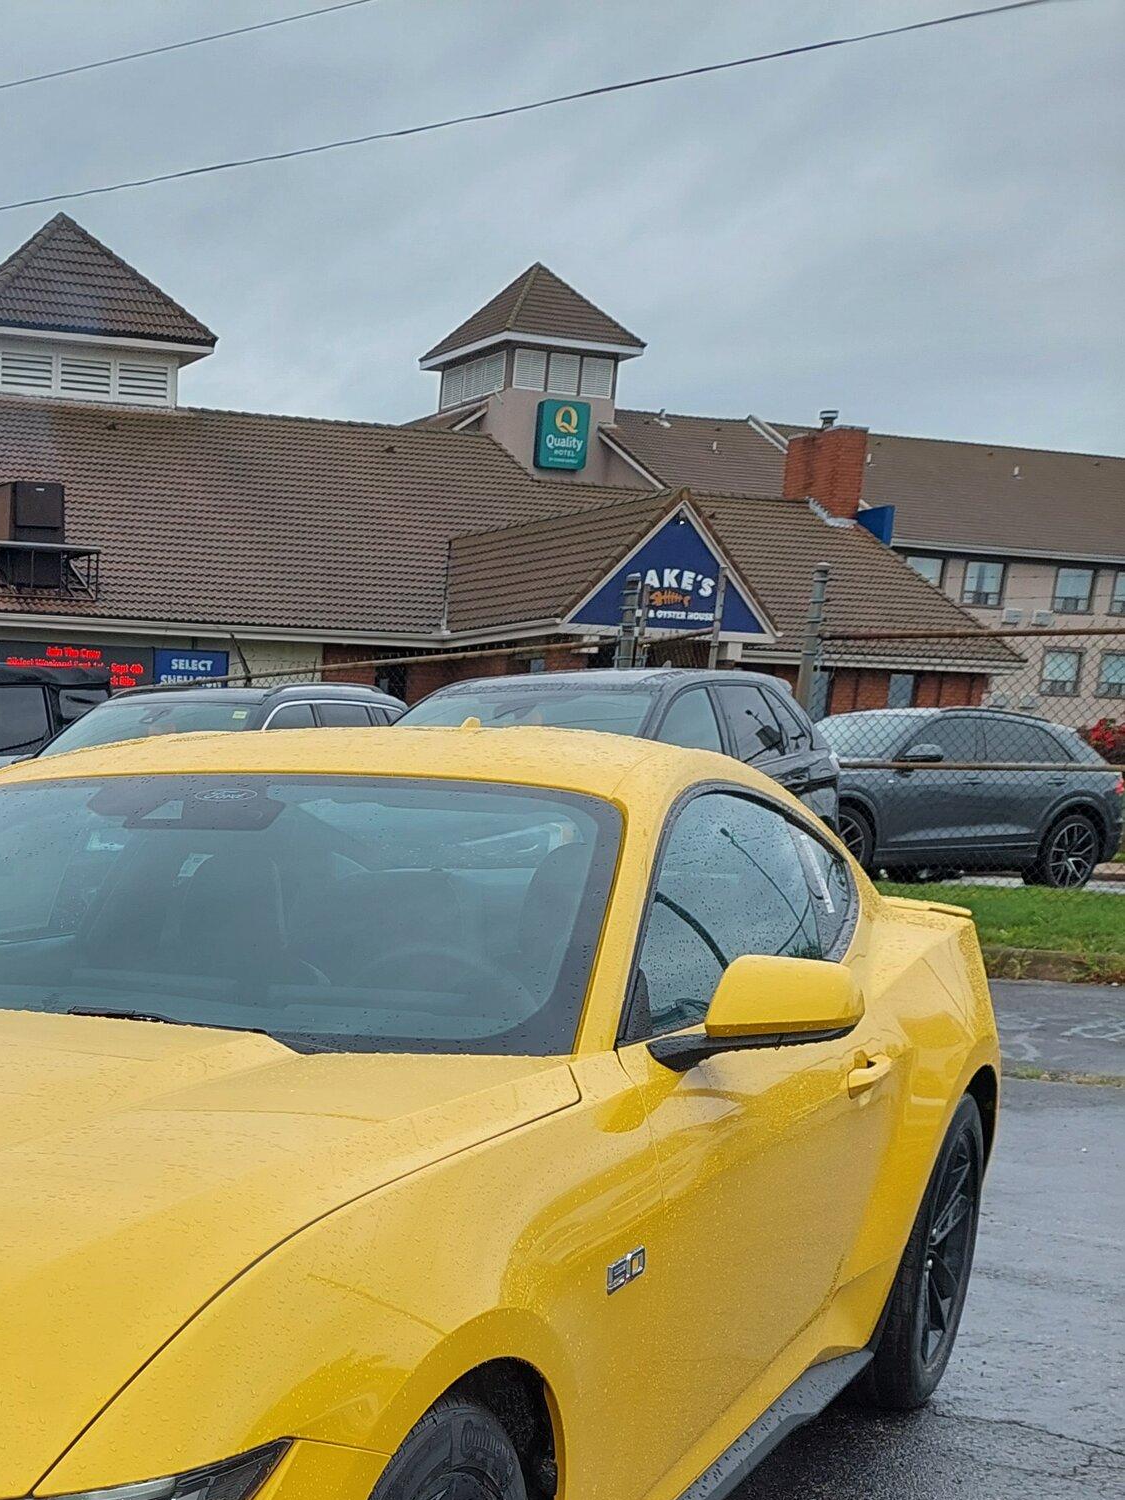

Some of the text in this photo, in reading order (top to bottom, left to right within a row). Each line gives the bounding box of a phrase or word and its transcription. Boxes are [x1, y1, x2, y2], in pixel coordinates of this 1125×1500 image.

[555, 406, 578, 434] Q
[546, 434, 583, 452] Quality
[554, 449, 575, 457] HOTEL
[627, 568, 715, 597] AKE'S
[656, 610, 686, 619] OYSTER
[687, 611, 715, 621] HOUSE
[170, 657, 213, 671] SELECT
